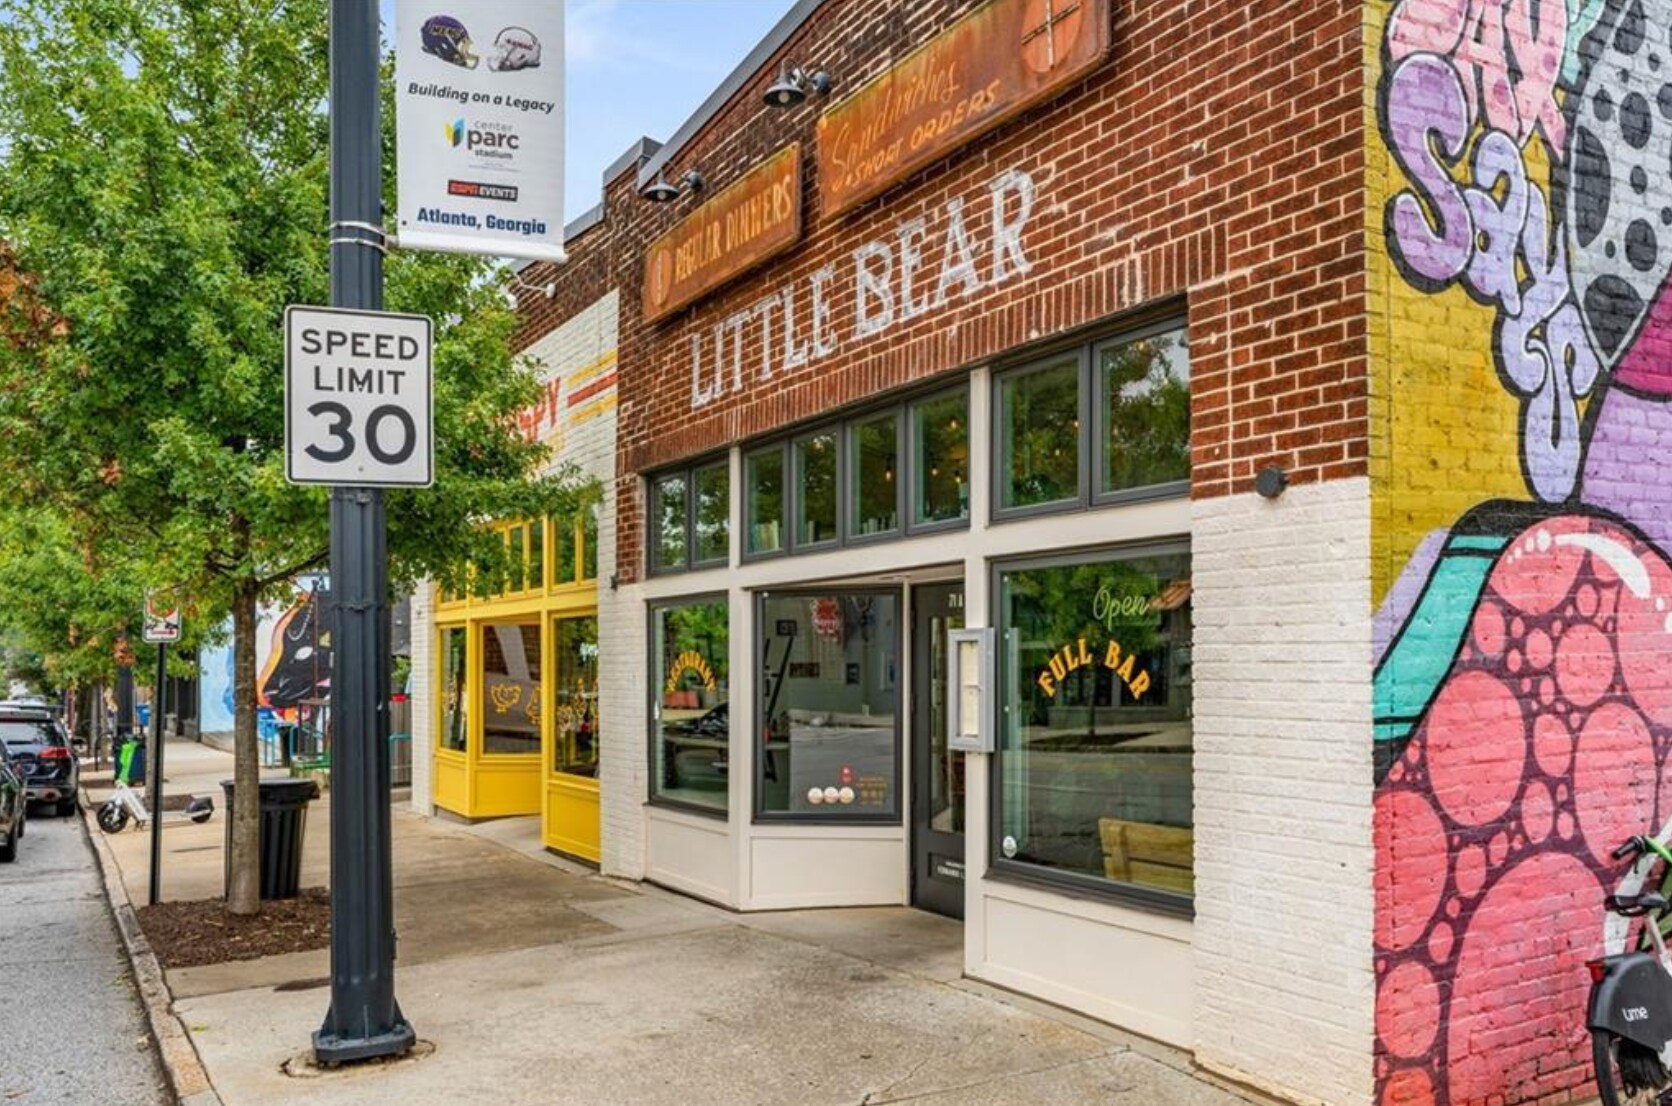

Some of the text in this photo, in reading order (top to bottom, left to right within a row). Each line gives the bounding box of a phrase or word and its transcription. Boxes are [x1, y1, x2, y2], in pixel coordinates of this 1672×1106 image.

[408, 82, 555, 114] Building on a Legacy
[474, 121, 513, 131] center
[910, 79, 1000, 150] ORDERS
[468, 130, 519, 150] parc
[475, 149, 513, 159] stadium
[417, 207, 546, 235] Atlanta, Georgia
[725, 174, 791, 252] DINNERS
[690, 170, 1034, 412] LITTLE BEAR
[301, 329, 419, 360] SPEED
[314, 365, 406, 395] LIMIT
[304, 400, 417, 465] 30
[1093, 585, 1150, 632] Open
[1038, 638, 1151, 700] FULL BAR
